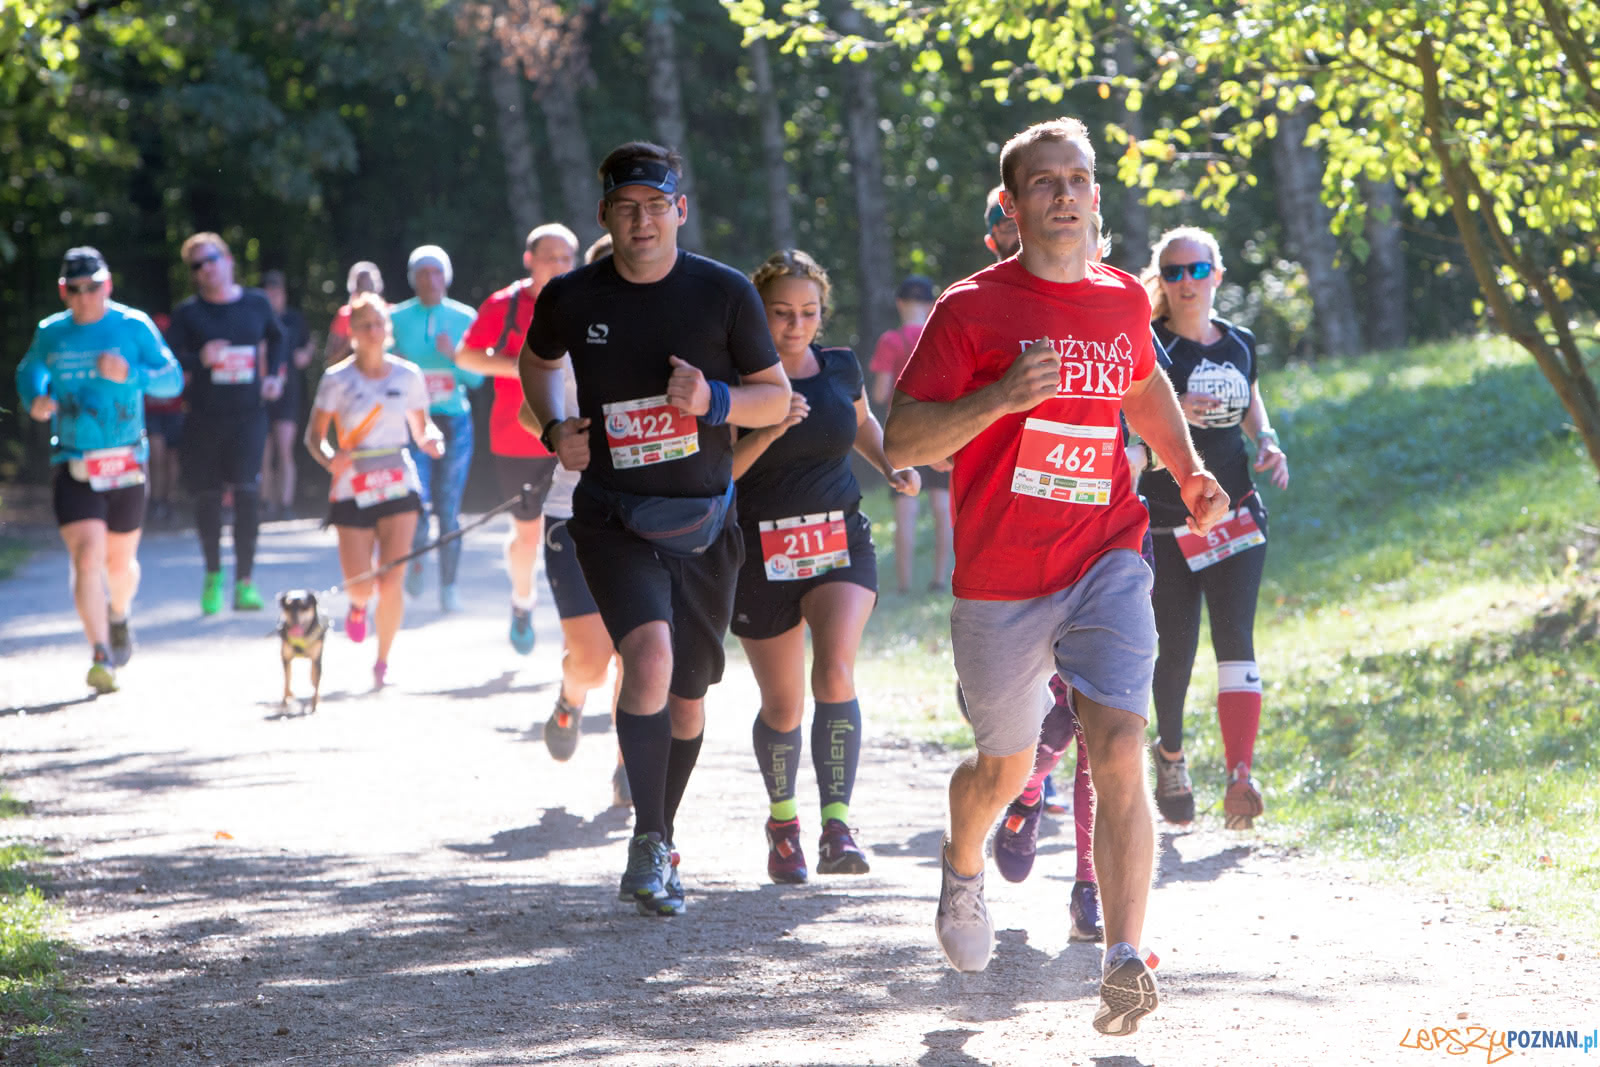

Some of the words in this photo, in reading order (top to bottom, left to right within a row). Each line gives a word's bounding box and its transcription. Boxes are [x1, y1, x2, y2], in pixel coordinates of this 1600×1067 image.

[1019, 334, 1120, 363] DUŻYNA
[630, 412, 675, 439] 422
[1045, 443, 1096, 472] 462
[783, 529, 824, 555] 211
[824, 719, 855, 796] kalenji
